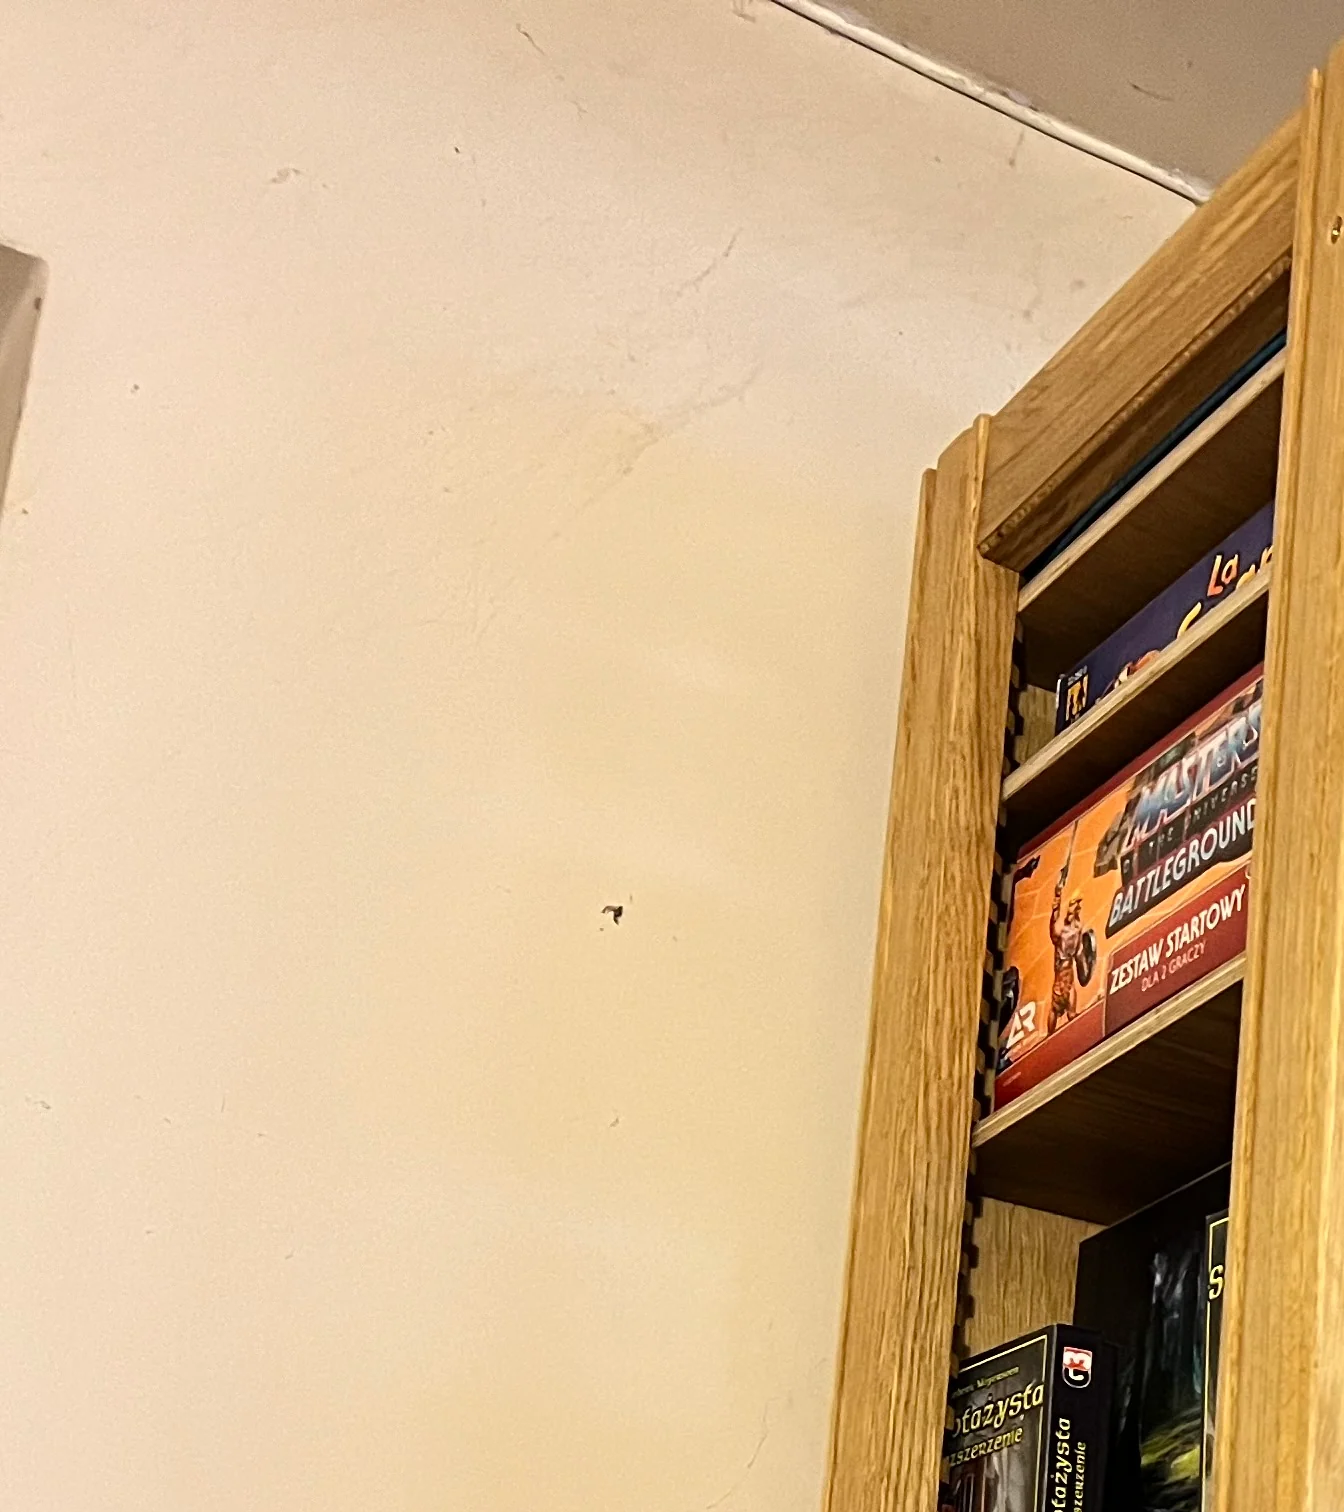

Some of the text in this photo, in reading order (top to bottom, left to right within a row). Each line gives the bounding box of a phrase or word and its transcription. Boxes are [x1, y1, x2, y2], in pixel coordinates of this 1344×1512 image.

[1206, 554, 1239, 597] La
[1109, 883, 1246, 995] ZESTAW STARTOWY
[1141, 971, 1161, 993] DLA
[1167, 940, 1207, 975] GRACZY
[952, 1380, 1045, 1440] tażysta
